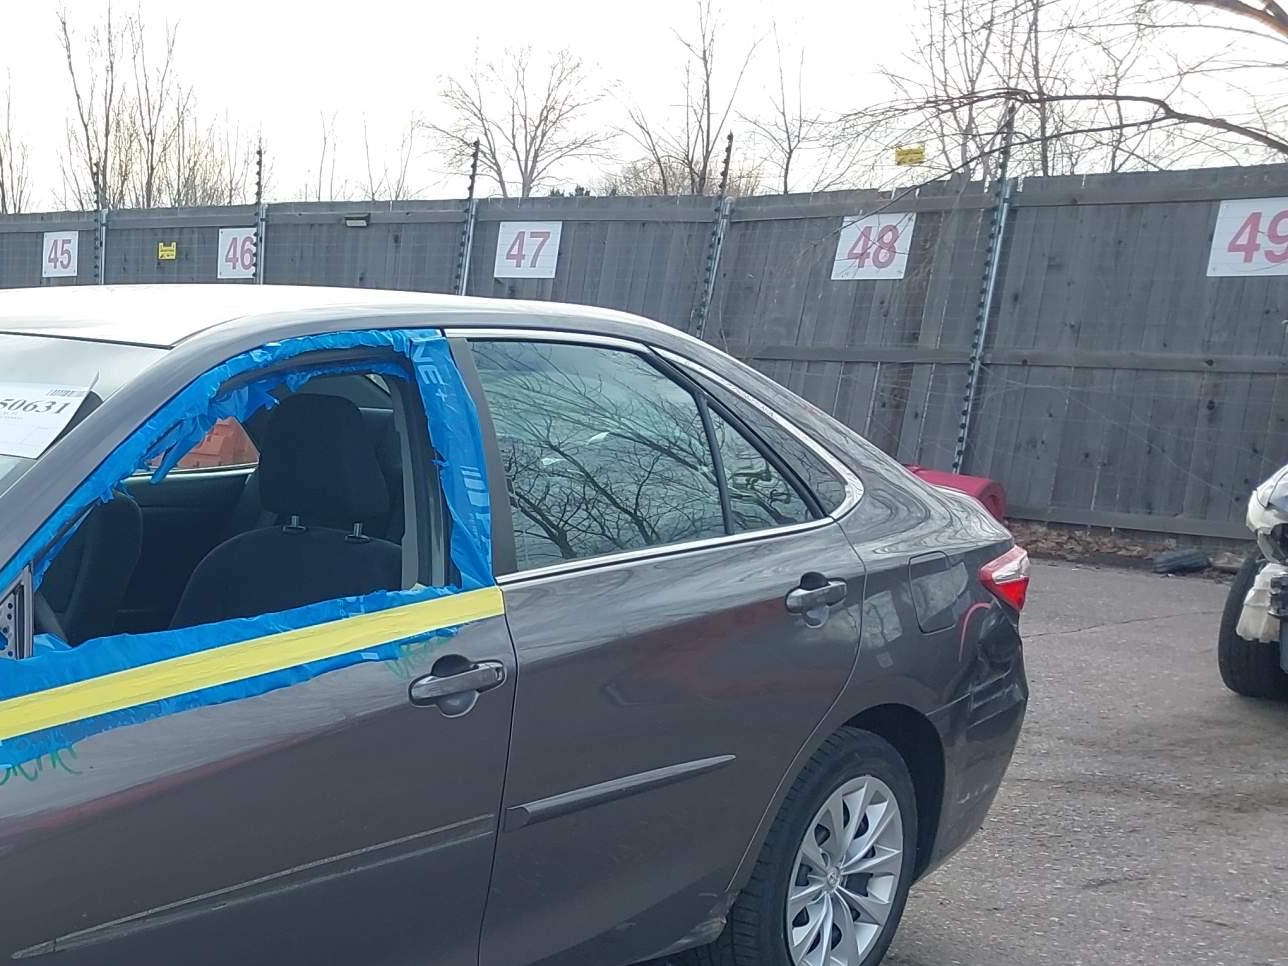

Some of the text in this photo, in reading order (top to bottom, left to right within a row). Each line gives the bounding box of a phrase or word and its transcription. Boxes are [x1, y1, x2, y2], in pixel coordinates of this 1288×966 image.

[48, 239, 72, 270] 45
[225, 236, 254, 270] 46
[505, 231, 551, 268] 47
[848, 224, 899, 269] 48
